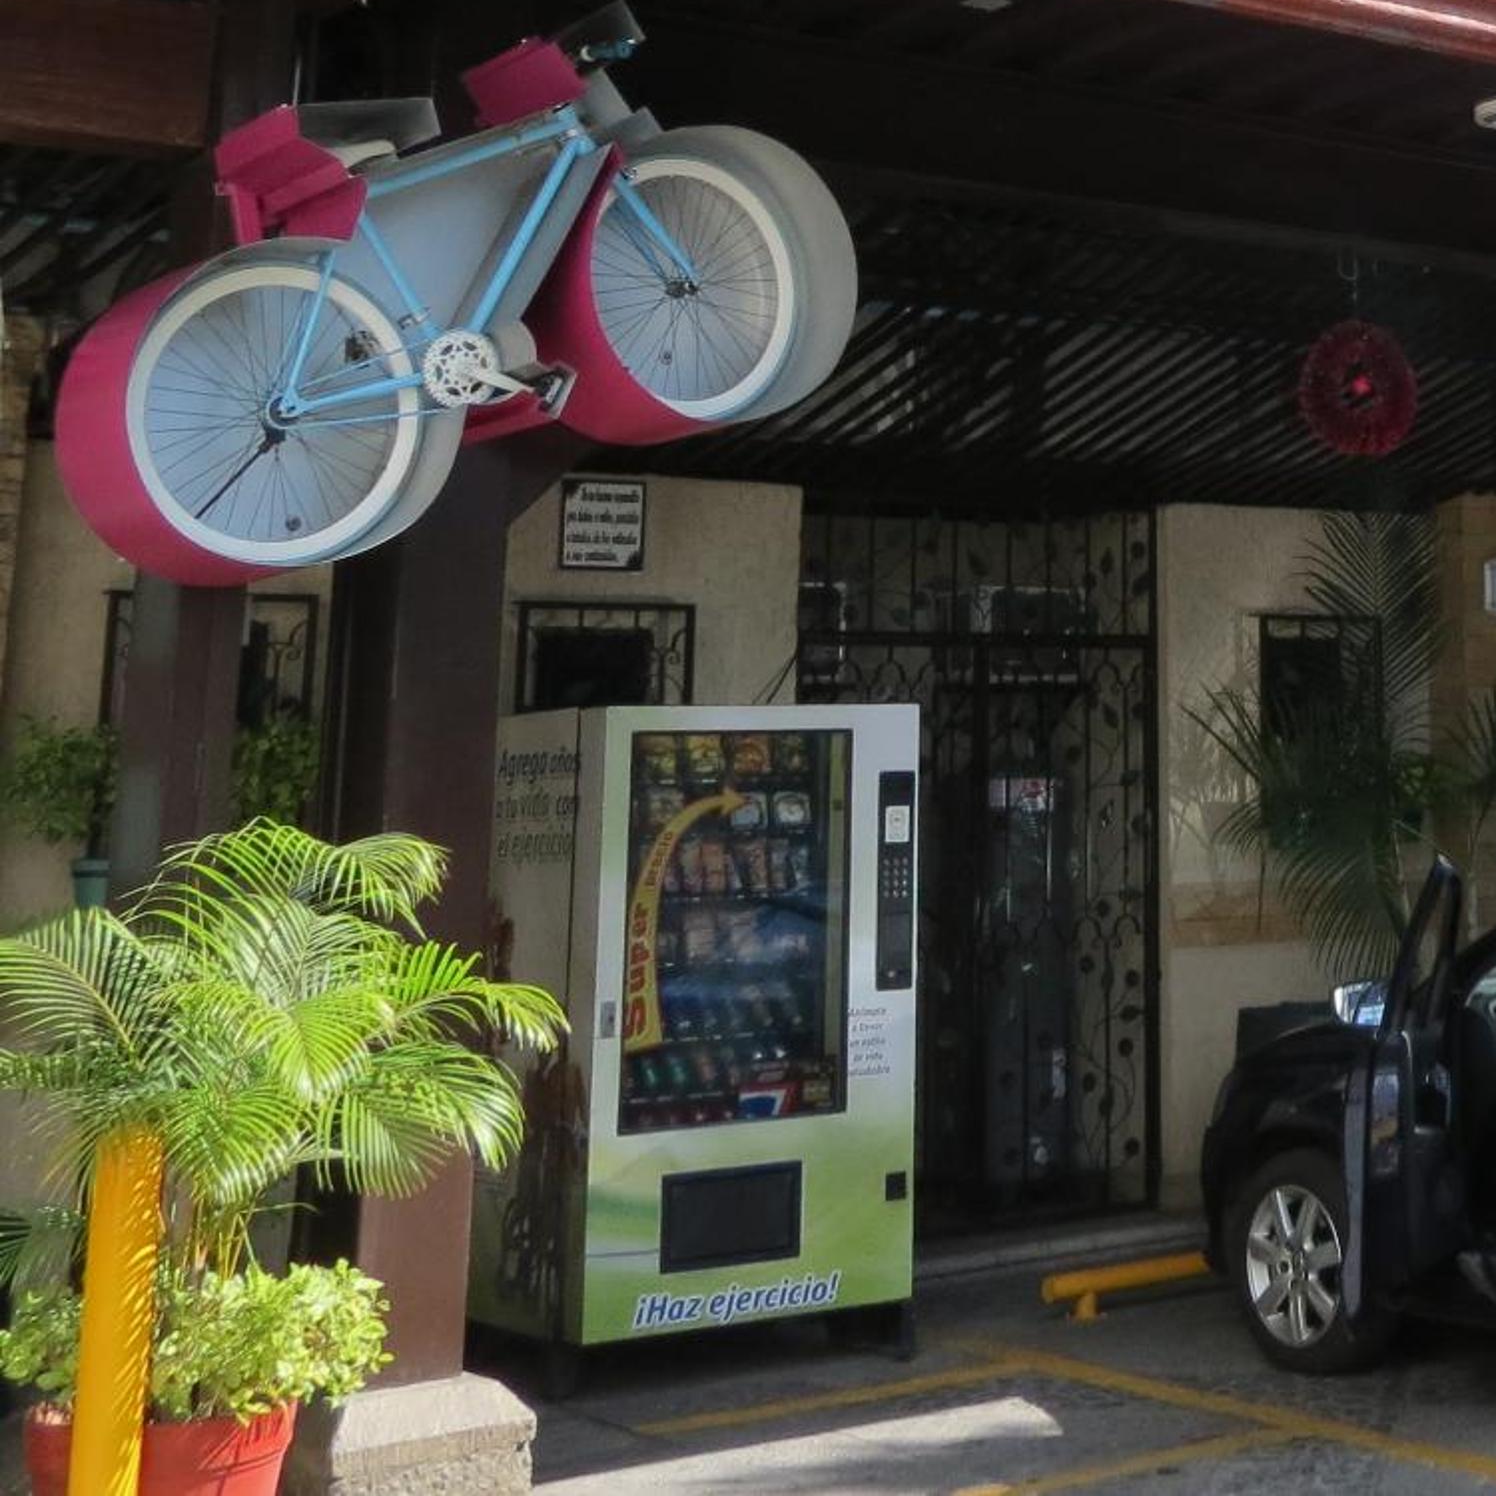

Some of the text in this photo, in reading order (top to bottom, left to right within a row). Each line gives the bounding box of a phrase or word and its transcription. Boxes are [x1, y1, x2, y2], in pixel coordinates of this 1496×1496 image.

[497, 749, 546, 785] Agrega
[624, 902, 650, 1041] Super
[635, 1271, 839, 1326] ¡Haz ejercicio!
